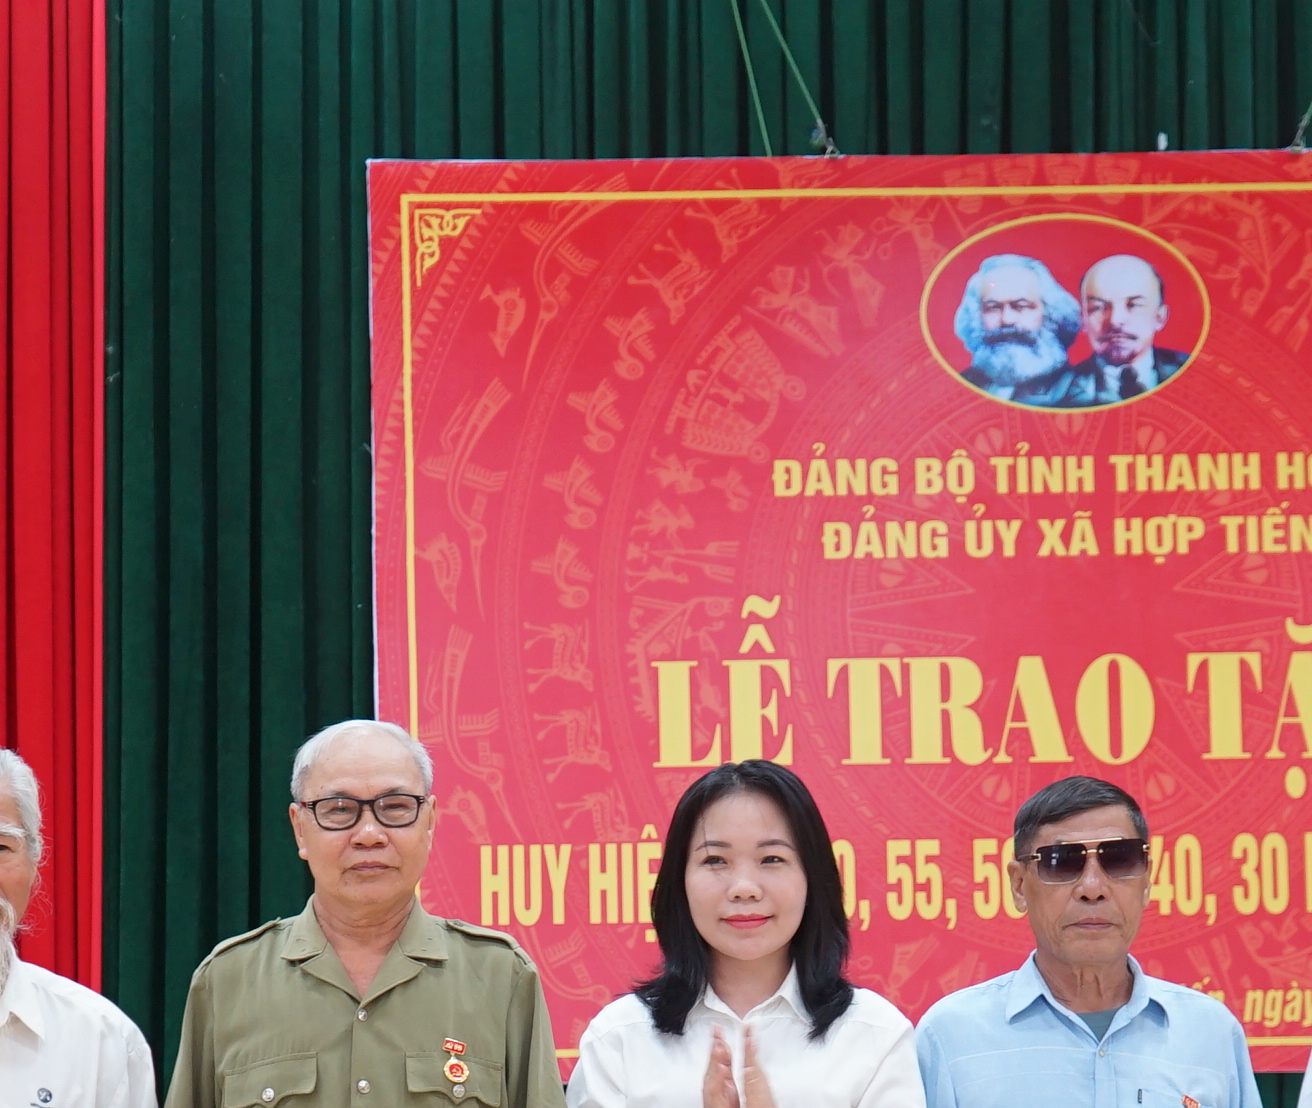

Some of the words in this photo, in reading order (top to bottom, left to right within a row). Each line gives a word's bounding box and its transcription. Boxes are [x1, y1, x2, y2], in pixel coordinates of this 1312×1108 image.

[772, 442, 900, 497] ĐẢNG
[914, 449, 976, 503] BỘ
[989, 442, 1096, 494] TỈNH
[1108, 451, 1262, 493] THANH
[821, 505, 950, 560] ĐẢNG
[963, 503, 1023, 558] ỦY
[1036, 510, 1100, 557] XÃ
[1113, 515, 1207, 564] HỢP
[651, 594, 794, 768] LỄ
[826, 652, 1156, 766] TRAO
[479, 842, 573, 926] HUY
[588, 823, 662, 943] HIỆ
[886, 838, 958, 930] 55,
[1231, 831, 1290, 916] 30
